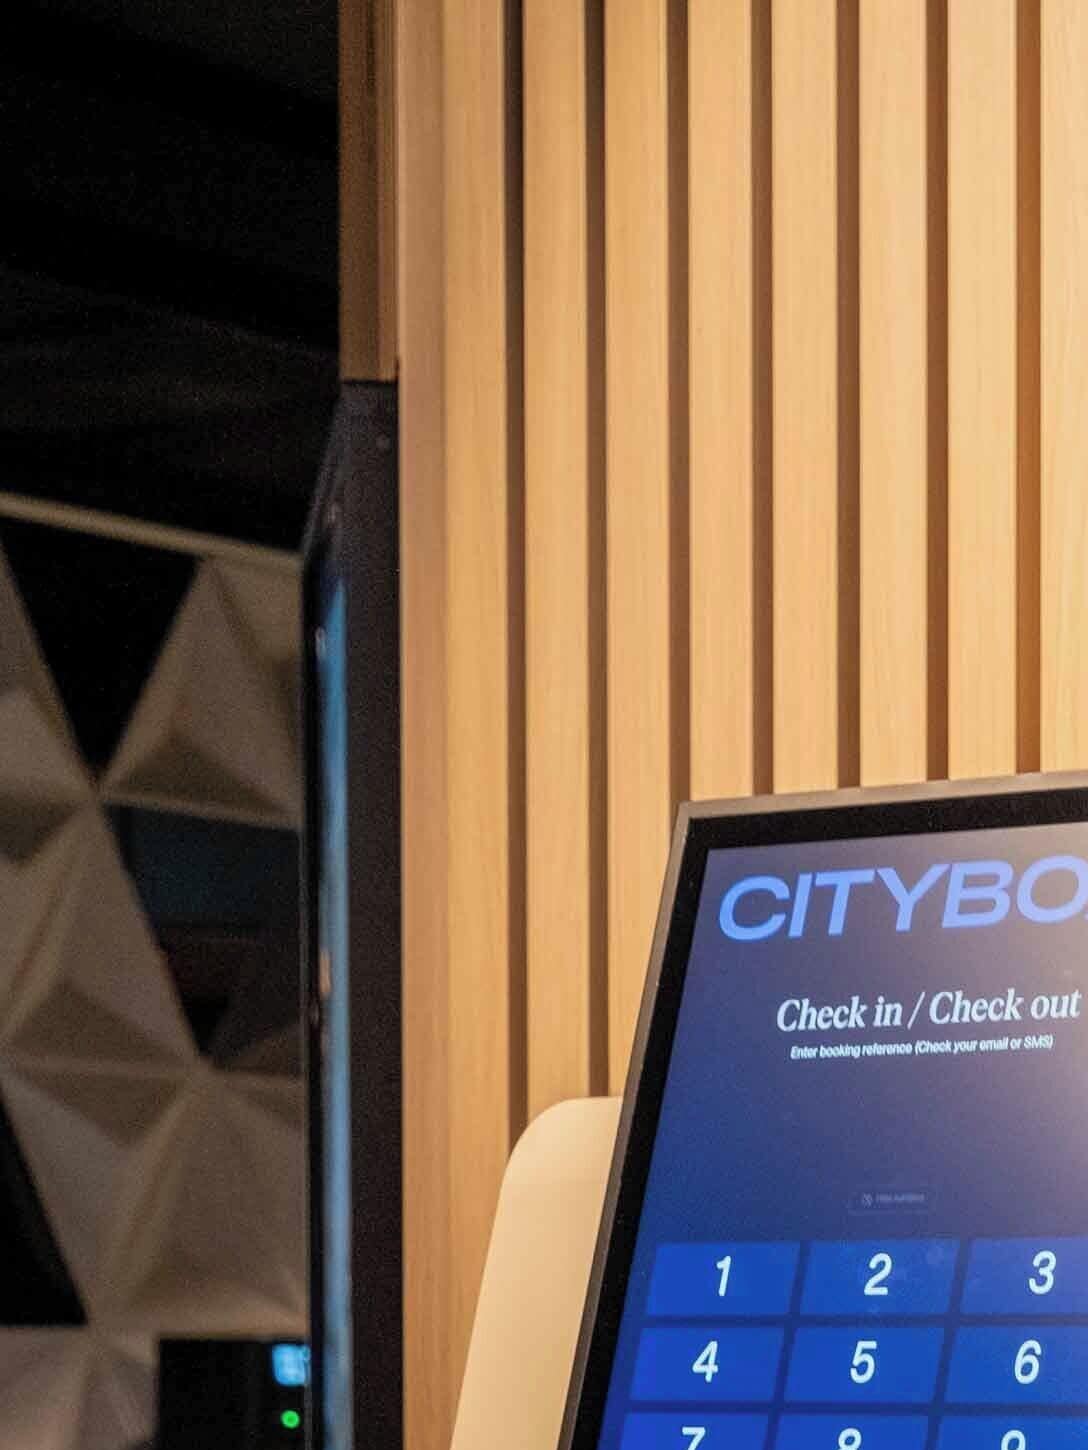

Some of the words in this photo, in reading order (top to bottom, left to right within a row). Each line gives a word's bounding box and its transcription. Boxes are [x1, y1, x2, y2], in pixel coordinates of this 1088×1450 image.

[777, 996, 867, 1032] Check
[872, 996, 902, 1027] in
[907, 991, 926, 1030] /
[929, 988, 1024, 1024] Check
[1030, 989, 1082, 1020] out
[790, 1046, 819, 1060] Enter
[820, 1044, 861, 1059] booking
[862, 1042, 913, 1056] reference
[914, 1040, 952, 1055] (Check
[953, 1040, 978, 1054] your
[979, 1037, 1009, 1051] email
[1010, 1038, 1022, 1049] or
[1023, 1034, 1054, 1050] SMS)
[716, 1255, 732, 1297] 1
[863, 1253, 892, 1296] 2
[1028, 1250, 1057, 1295] 3
[692, 1340, 719, 1383] 4
[850, 1340, 877, 1384] 5
[1014, 1339, 1042, 1384] 6
